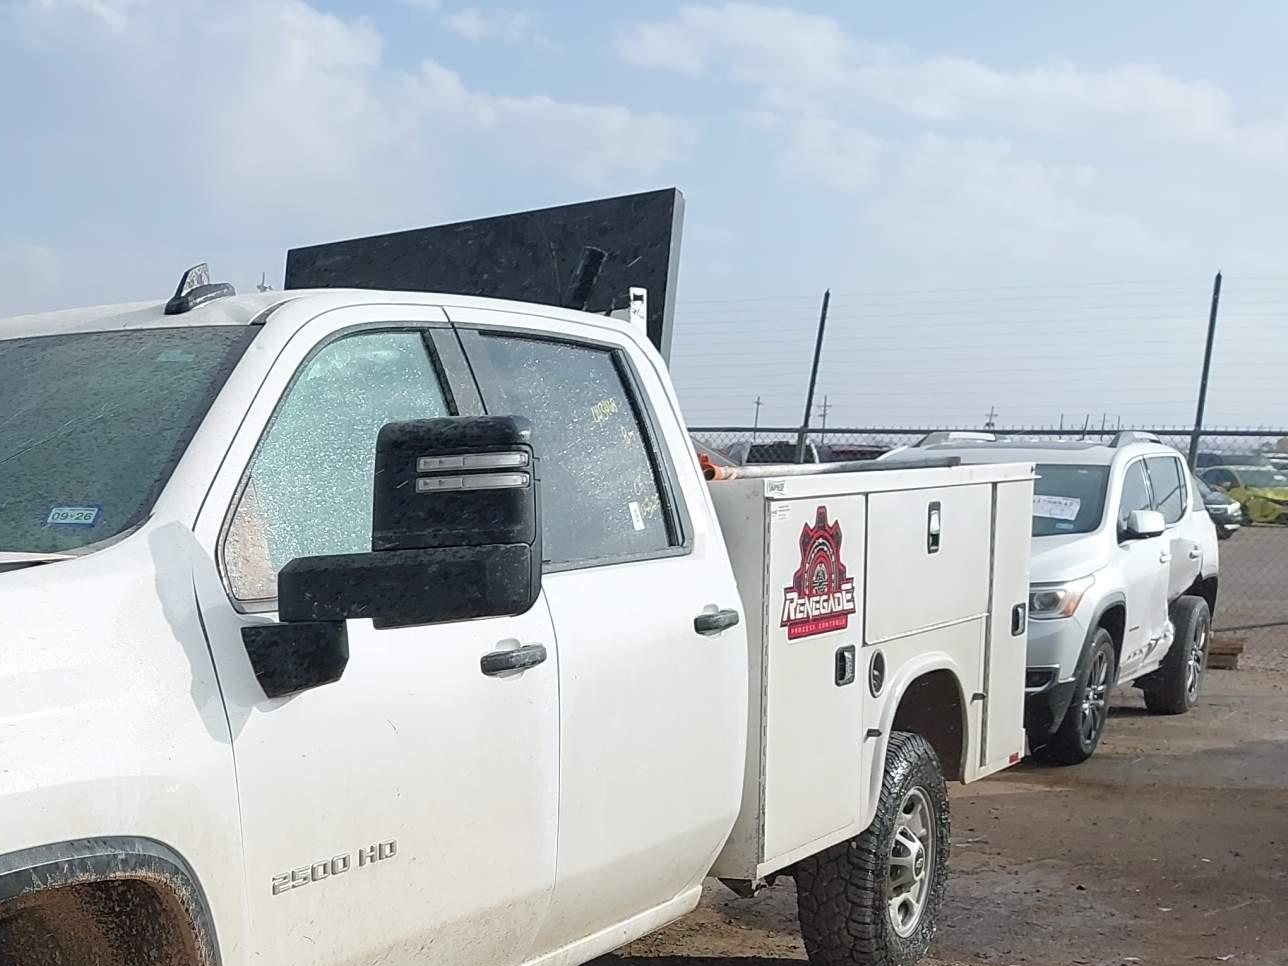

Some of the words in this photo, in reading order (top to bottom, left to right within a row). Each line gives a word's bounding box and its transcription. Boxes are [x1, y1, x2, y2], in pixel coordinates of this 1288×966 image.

[782, 583, 854, 622] RENEGADE
[271, 853, 351, 896] 2500
[358, 839, 398, 867] HD
